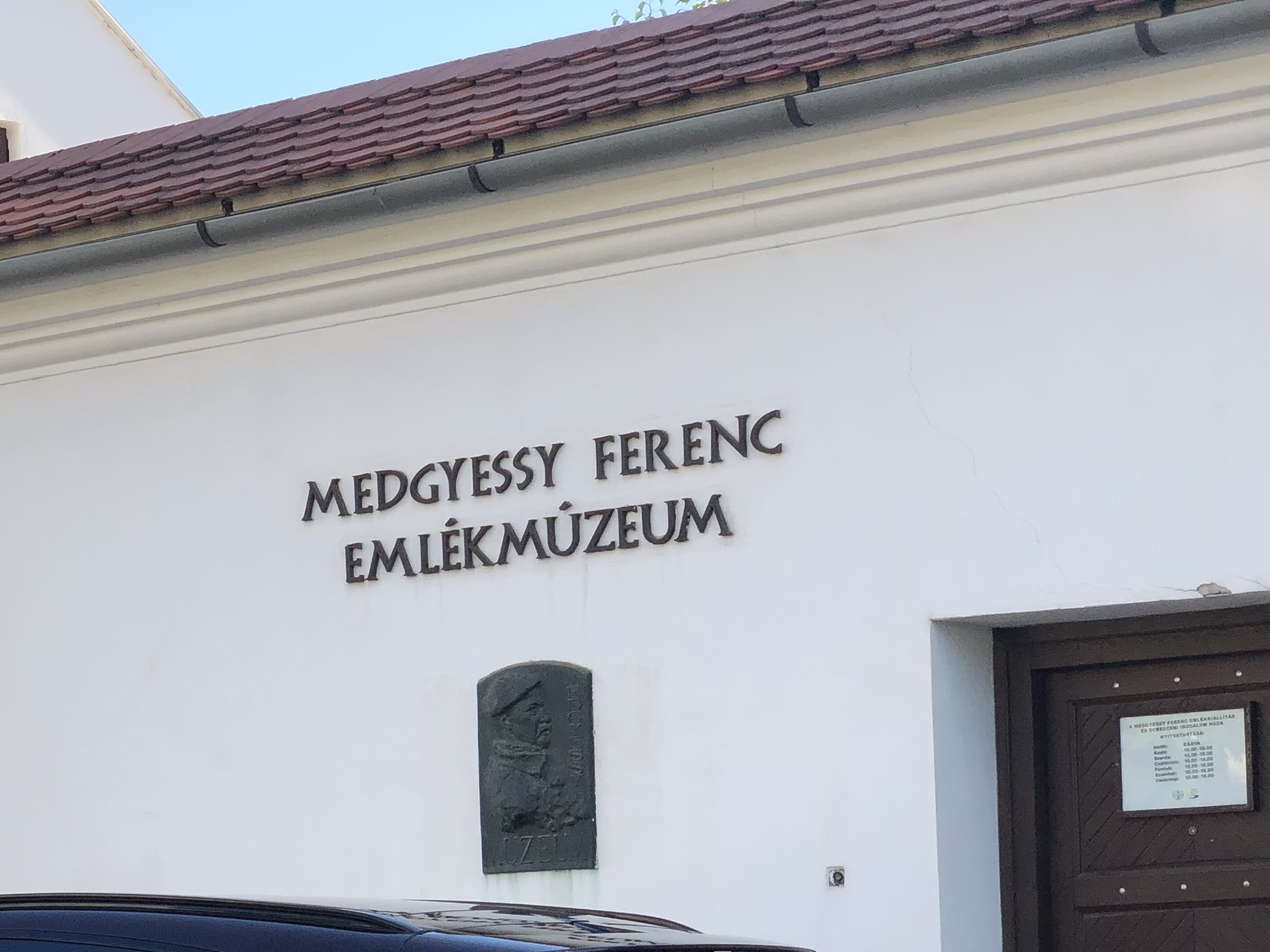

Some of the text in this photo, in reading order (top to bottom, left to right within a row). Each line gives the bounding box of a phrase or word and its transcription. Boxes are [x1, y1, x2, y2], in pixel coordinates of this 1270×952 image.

[301, 409, 783, 522] MEDGYESSY FERENC
[345, 493, 734, 583] EMLÉKMÚZEUM
